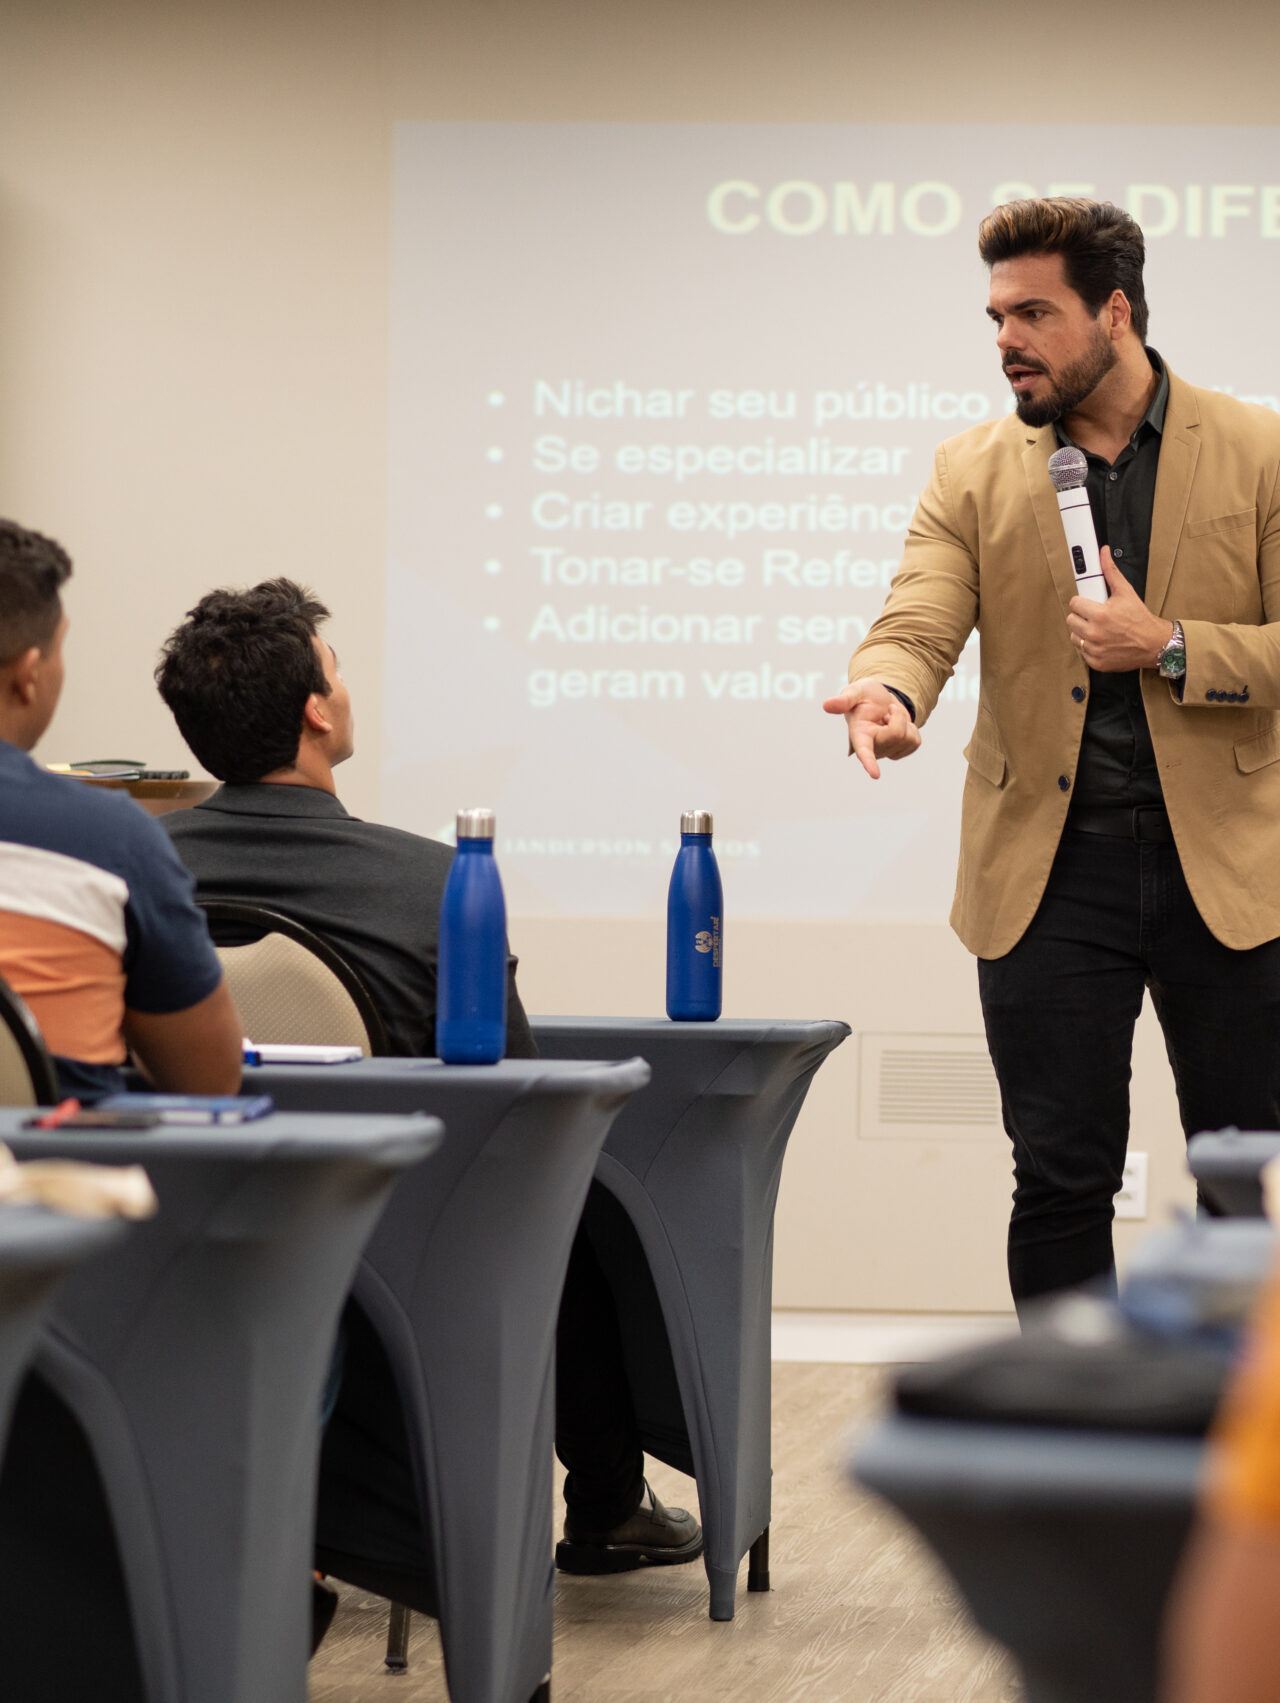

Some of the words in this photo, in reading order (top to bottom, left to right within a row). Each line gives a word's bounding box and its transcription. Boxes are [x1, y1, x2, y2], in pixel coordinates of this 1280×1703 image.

[706, 179, 962, 236] COMO
[534, 380, 695, 420] Nichar
[708, 389, 796, 421] seu
[815, 382, 990, 428] público
[533, 435, 600, 475] Se
[616, 438, 910, 483] especializar
[531, 491, 652, 531] Criar
[529, 547, 746, 587] Tonar-se
[529, 605, 762, 646] Adicionar
[528, 667, 686, 707] geram
[702, 664, 824, 701] valor
